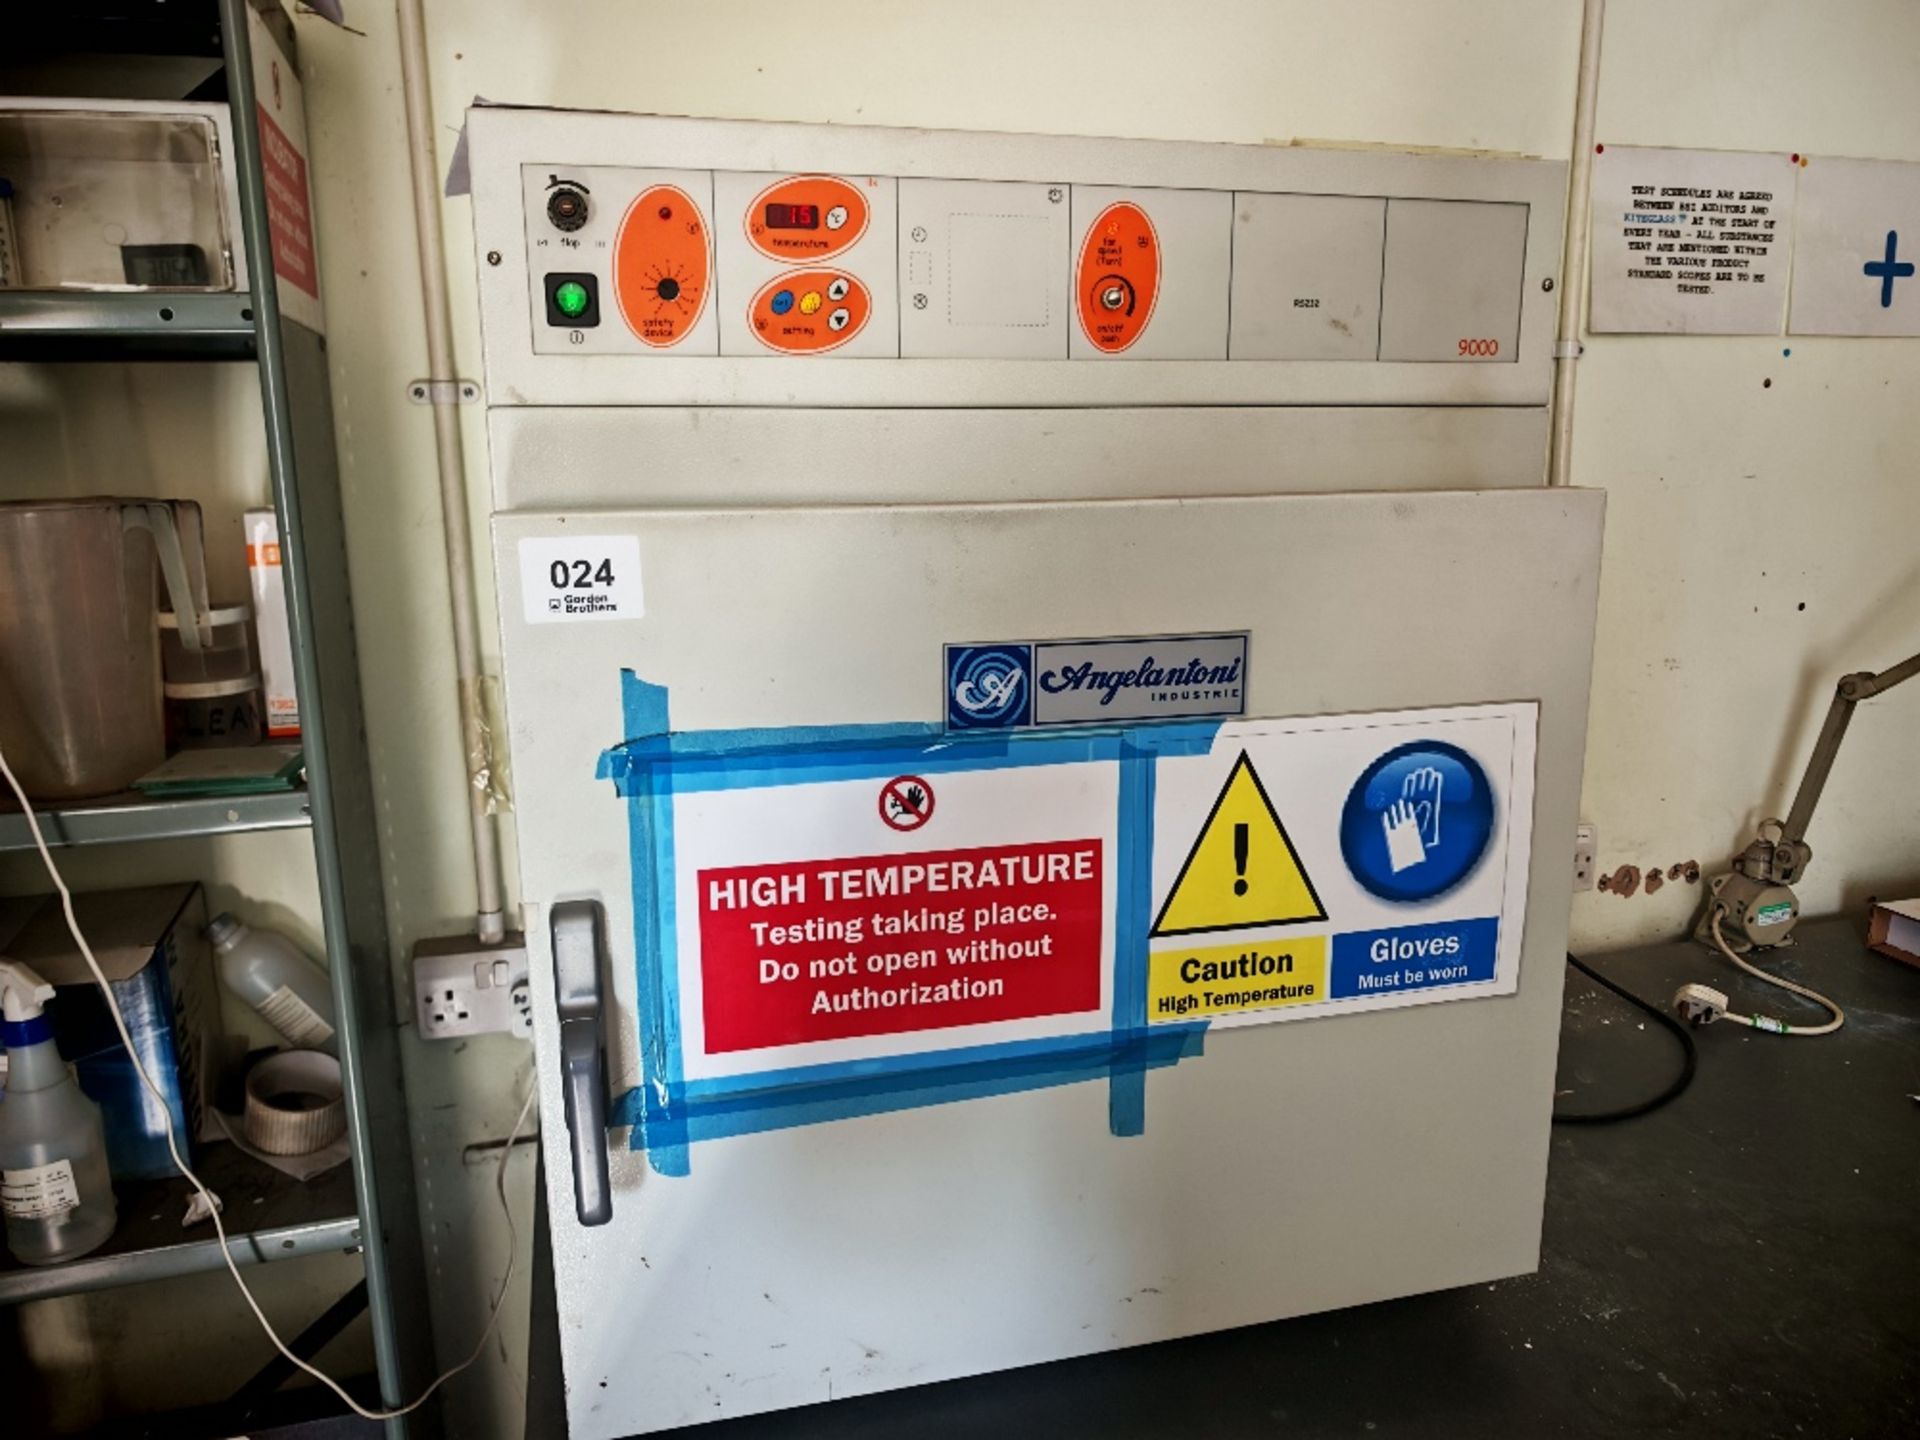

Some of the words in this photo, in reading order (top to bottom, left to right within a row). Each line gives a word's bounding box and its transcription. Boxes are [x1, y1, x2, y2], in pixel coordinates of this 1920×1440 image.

[1632, 186, 1656, 196] TEST
[1661, 187, 1712, 199] SCHEDULES
[1716, 190, 1734, 200] ARE
[1739, 191, 1773, 202] AGREED
[789, 205, 812, 225] 15
[1633, 200, 1675, 210] BETWEEN
[1700, 203, 1747, 214] AUDITORS
[1751, 205, 1769, 215] AND
[1691, 216, 1704, 225] AT
[1709, 216, 1727, 227] THE
[1731, 218, 1759, 228] START
[1764, 220, 1776, 229] OF
[1623, 228, 1653, 237] EVERY
[1658, 229, 1681, 239] YEAR
[1697, 230, 1715, 240] ALL
[1720, 232, 1775, 243] SUBSTANCES
[560, 237, 581, 250] flap
[773, 238, 829, 249] temperature
[1628, 241, 1652, 250] THAT
[1657, 243, 1675, 252] ARE
[1679, 243, 1730, 254] MENTIONED
[1734, 245, 1768, 256] WITHIN
[1645, 256, 1662, 266] THE
[1712, 258, 1750, 268] PRODUCT
[1627, 269, 1673, 279] STANDARD
[1678, 270, 1712, 281] SCOPES
[1716, 272, 1732, 281] ARE
[1737, 272, 1750, 281] TO
[1753, 273, 1766, 283] BE
[1677, 283, 1714, 295] TESTED.
[1293, 298, 1321, 308] RS232
[642, 318, 676, 329] safety
[644, 328, 674, 338] device
[783, 327, 815, 337] setting
[1458, 339, 1499, 356] 9000
[550, 558, 616, 589] 024
[564, 594, 608, 604] Gordon
[565, 602, 618, 613] Brothers
[1039, 656, 1242, 706] Angelantoni
[1151, 688, 1241, 702] INDUSTRIE
[709, 873, 806, 912] HIGH
[818, 850, 1094, 902] TEMPERATURE
[750, 916, 864, 947] Testing
[872, 906, 966, 937] taking
[974, 901, 1058, 936] place.
[1370, 936, 1460, 963] Gloves
[759, 958, 800, 984] Do
[809, 951, 859, 979] not
[867, 947, 938, 977] open
[946, 933, 1054, 965] without
[1180, 951, 1294, 984] Caution
[1358, 972, 1401, 990] Must
[1404, 968, 1424, 984] be
[1427, 964, 1469, 982] worn
[811, 975, 1004, 1015] Authorization
[1158, 995, 1199, 1014] High
[1203, 982, 1315, 1009] Temperature
